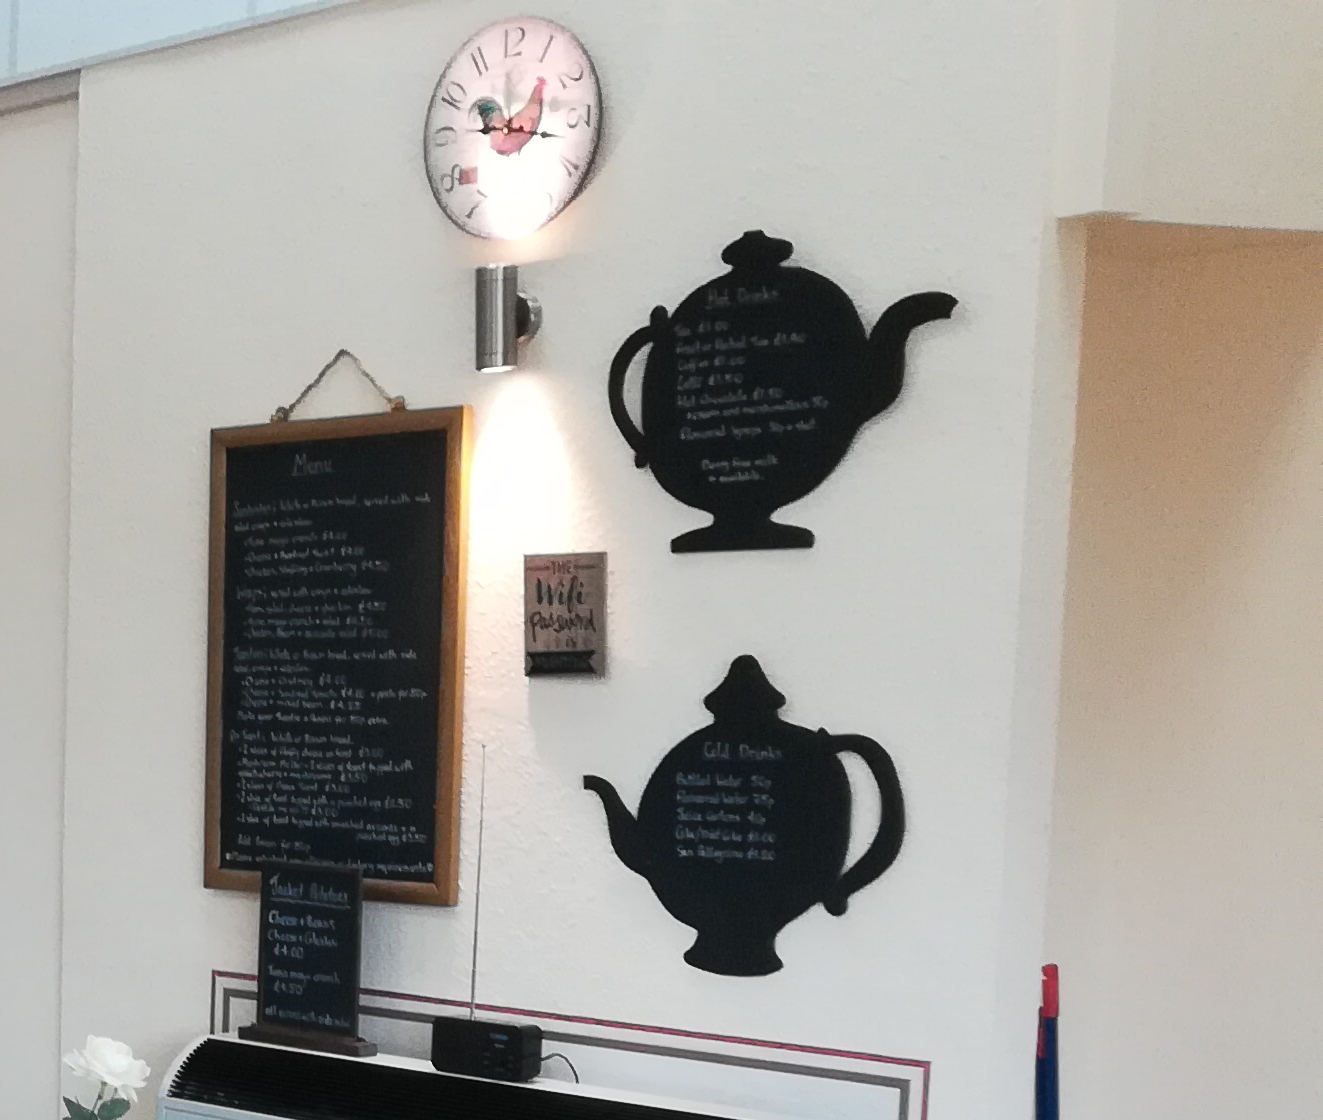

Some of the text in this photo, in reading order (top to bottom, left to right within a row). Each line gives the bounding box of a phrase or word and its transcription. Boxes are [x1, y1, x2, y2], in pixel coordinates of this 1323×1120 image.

[504, 26, 526, 59] 12
[539, 34, 556, 63] 1
[470, 46, 489, 77] 11
[558, 63, 584, 89] 2
[441, 80, 467, 110] 10
[566, 104, 591, 128] 3
[434, 126, 458, 147] 9
[440, 163, 462, 194] 8
[291, 453, 334, 477] Menu
[550, 560, 574, 576] THE
[703, 741, 731, 759] Cold
